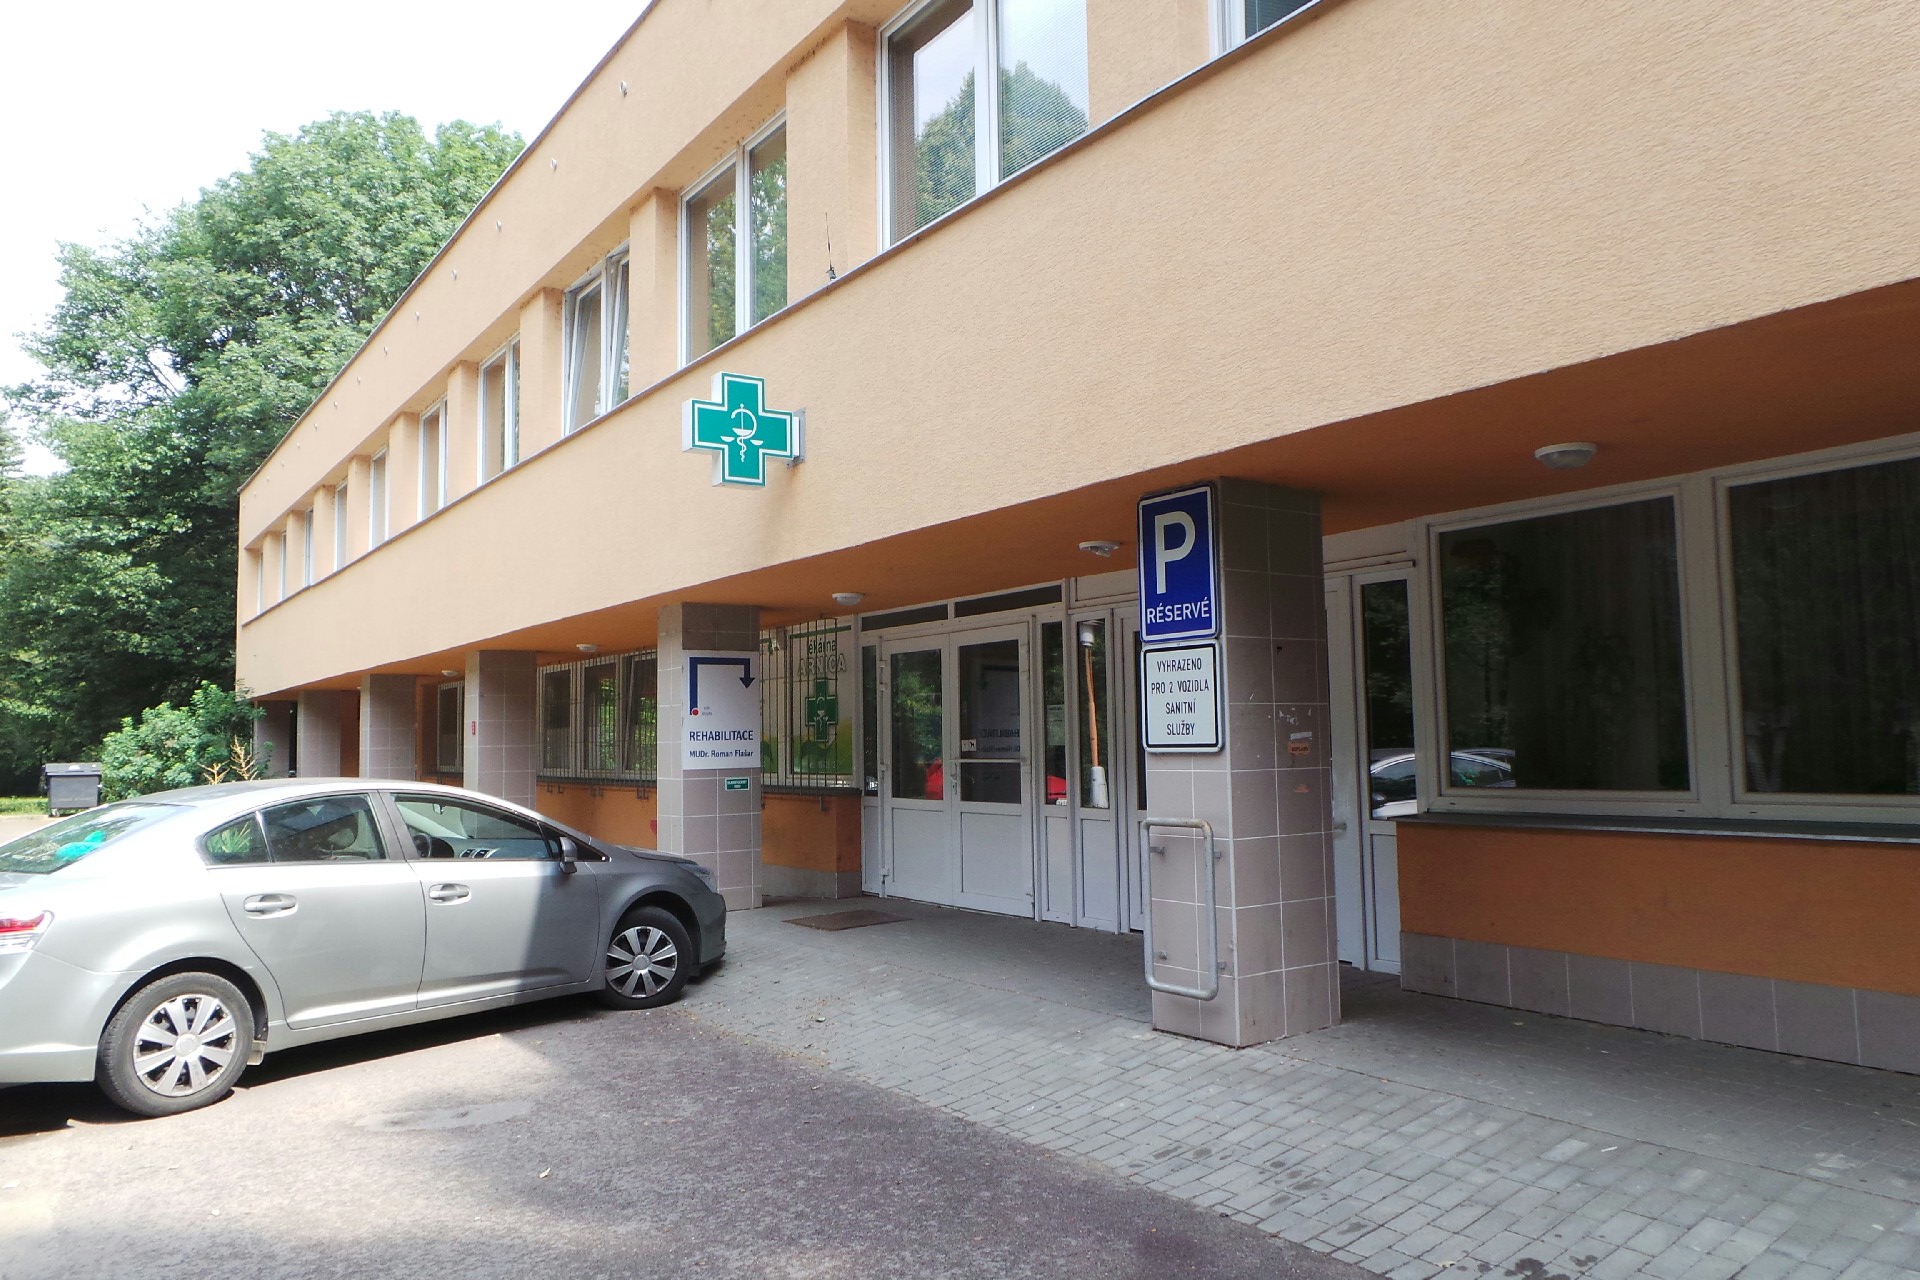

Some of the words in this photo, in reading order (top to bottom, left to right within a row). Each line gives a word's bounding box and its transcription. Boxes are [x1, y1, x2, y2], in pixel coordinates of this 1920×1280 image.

[1154, 511, 1196, 595] P
[1146, 597, 1210, 624] RÉSERVÉ
[807, 638, 837, 654] ékána
[797, 653, 847, 677] ARNICA
[1157, 658, 1202, 673] VYHRAZENO
[1151, 682, 1166, 694] PRO
[1169, 681, 1174, 693] 2
[1177, 679, 1210, 693] VOZIDLA
[1165, 698, 1196, 714] SANITNÍ
[689, 730, 754, 741] REHABILITACE
[1166, 720, 1195, 736] SLUŽBY
[689, 750, 710, 758] MUDr.
